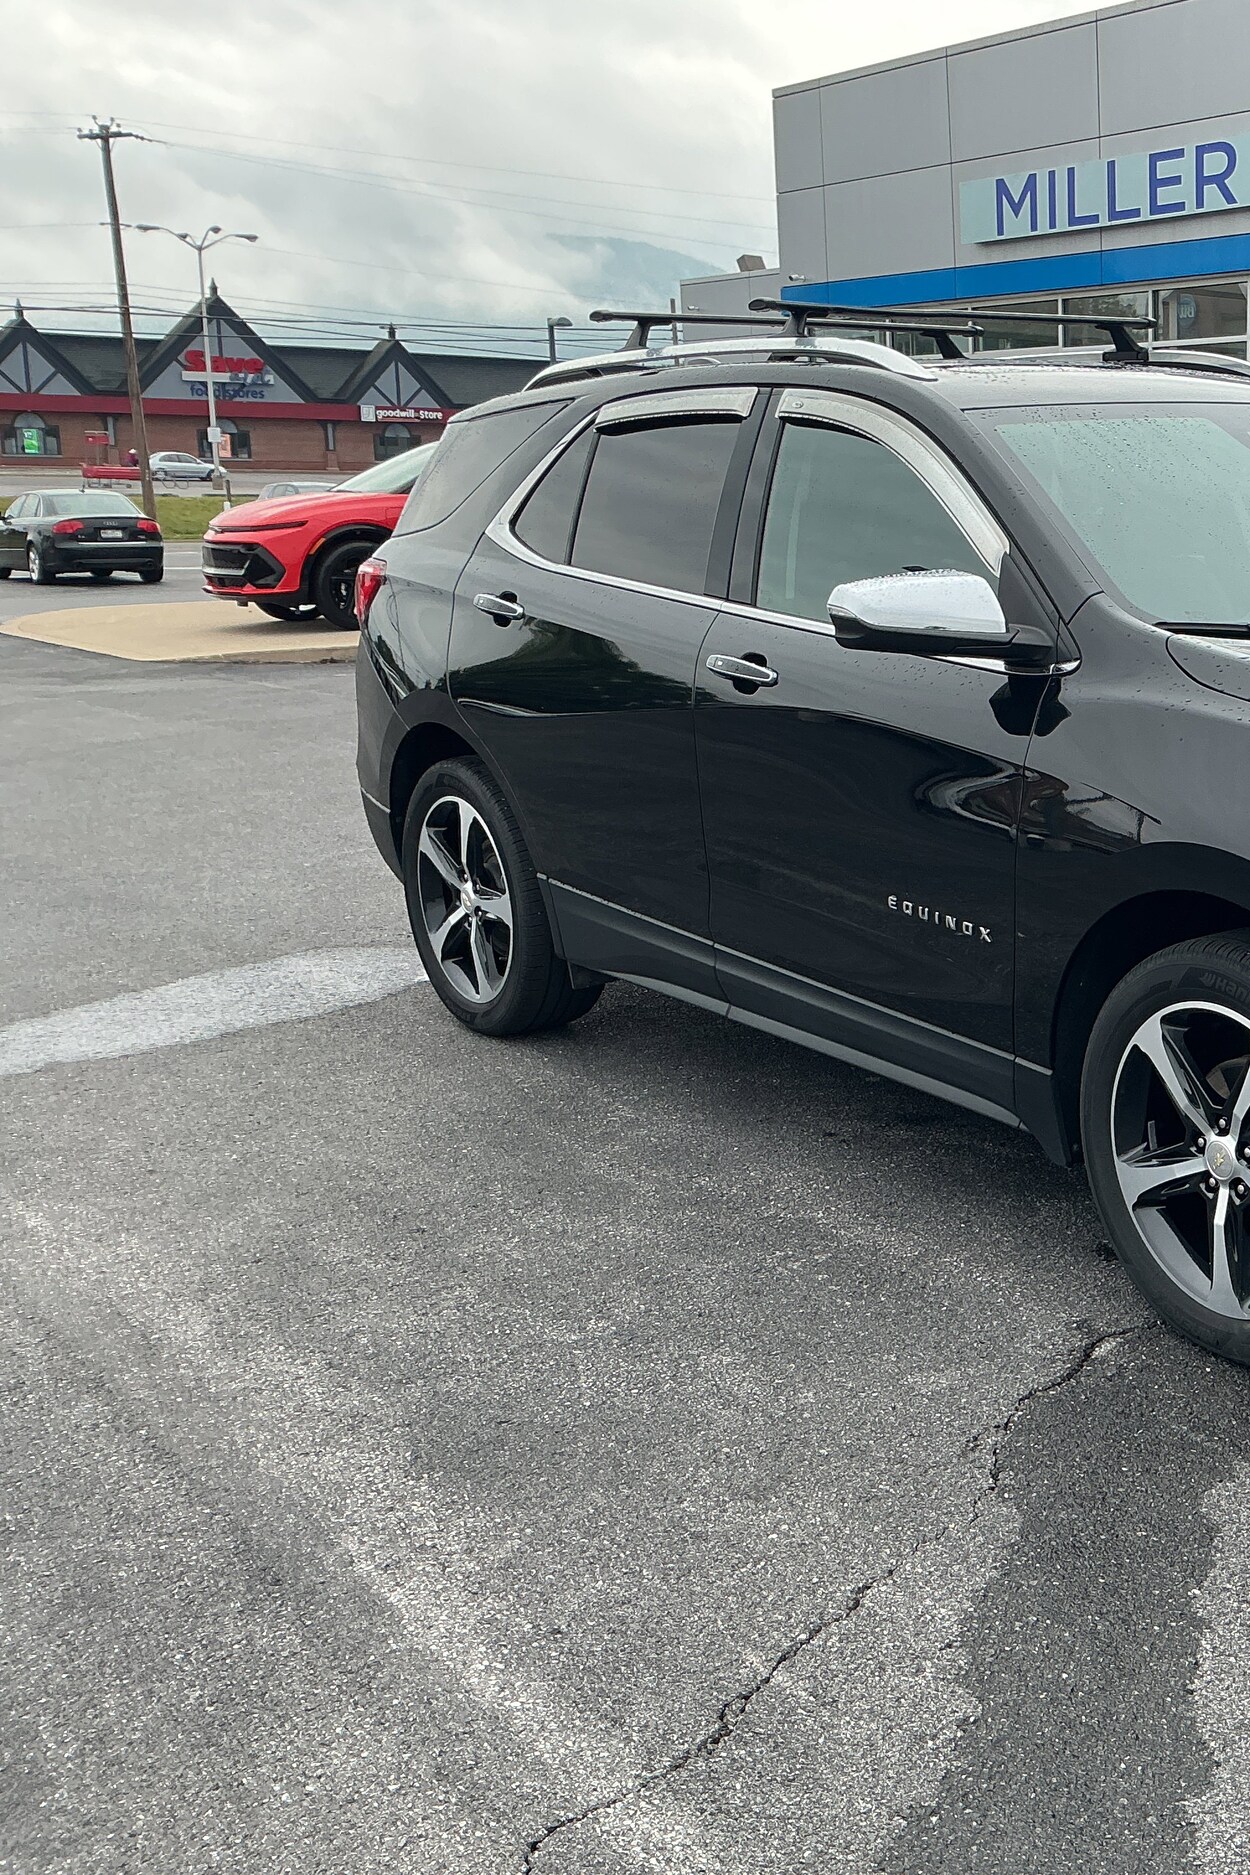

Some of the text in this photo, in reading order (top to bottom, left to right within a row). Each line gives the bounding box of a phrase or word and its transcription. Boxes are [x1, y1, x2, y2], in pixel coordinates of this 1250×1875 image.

[995, 140, 1239, 237] MILLER
[184, 349, 265, 374] Save
[225, 386, 265, 399] stores
[376, 408, 415, 420] goodwill
[887, 894, 992, 943] EQUINOX
